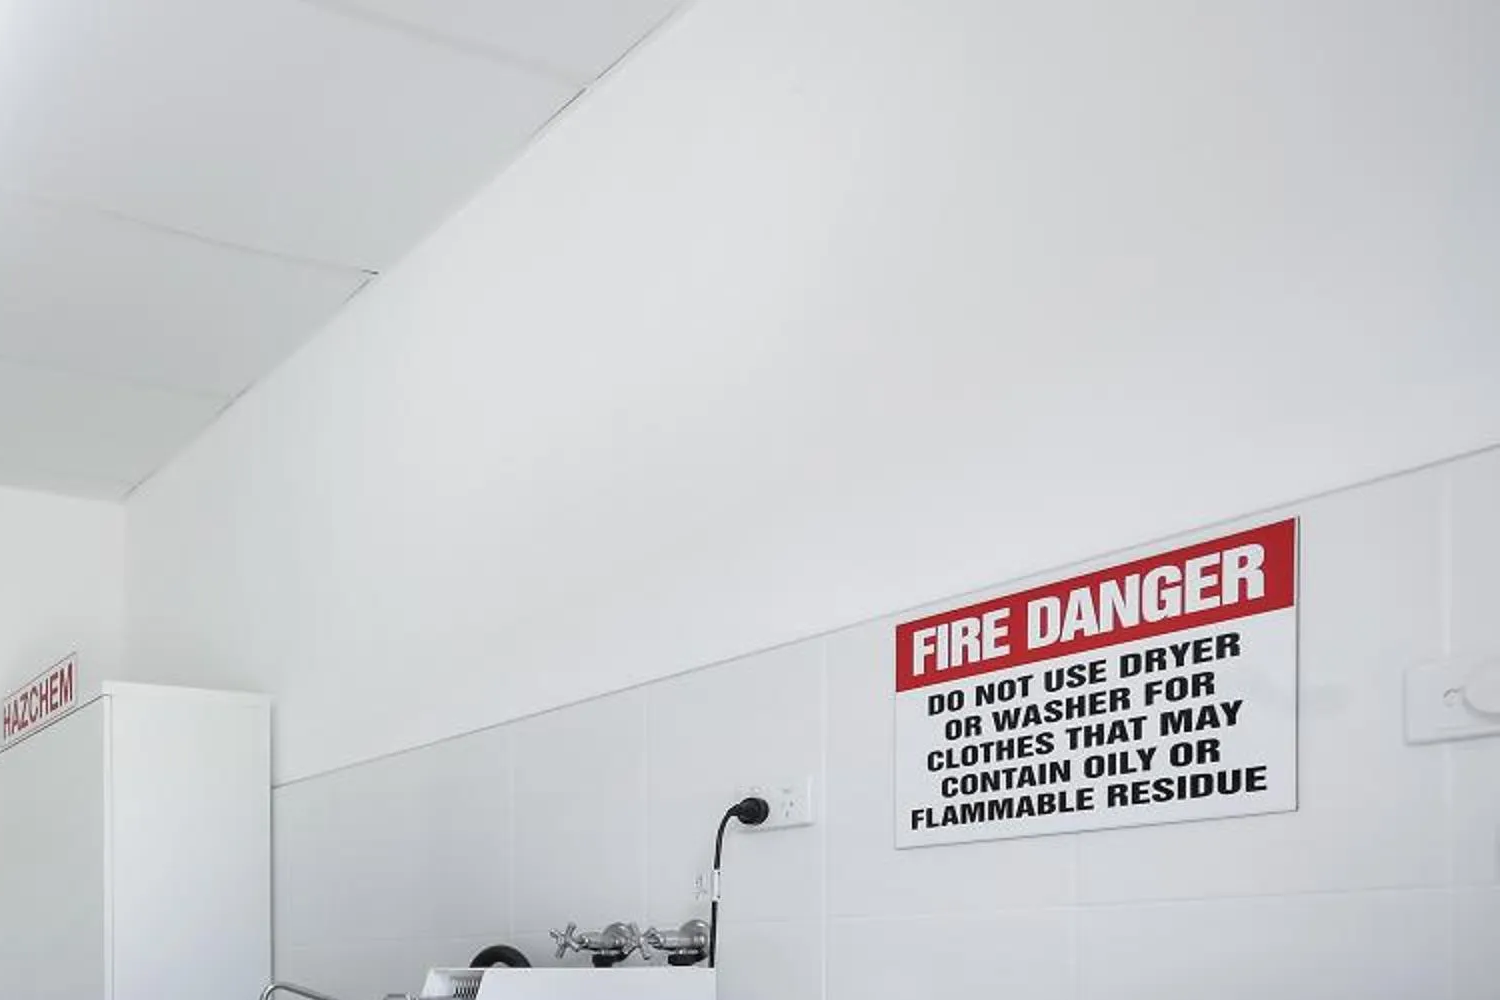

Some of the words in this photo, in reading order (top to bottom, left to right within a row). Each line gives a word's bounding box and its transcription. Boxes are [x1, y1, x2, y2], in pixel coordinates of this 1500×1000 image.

[912, 606, 1011, 677] FIRE
[1027, 542, 1265, 651] DANGER
[3, 661, 73, 740] HAZCHEM
[928, 690, 964, 716] DO
[975, 674, 1034, 708] NOT
[1044, 659, 1108, 693] USE
[1119, 631, 1241, 678] DRYER
[945, 716, 982, 741] OR
[992, 686, 1131, 732] WASHER
[1144, 671, 1216, 706] FOR
[927, 731, 1055, 772] CLOTHES
[1065, 715, 1148, 751] THAT
[1160, 699, 1243, 737] MAY
[941, 760, 1071, 798] CONTAIN
[1083, 747, 1157, 780] OILY
[1169, 738, 1221, 767] OR
[911, 788, 1095, 830] FLAMMABLE
[1107, 765, 1268, 807] RESIDUE
